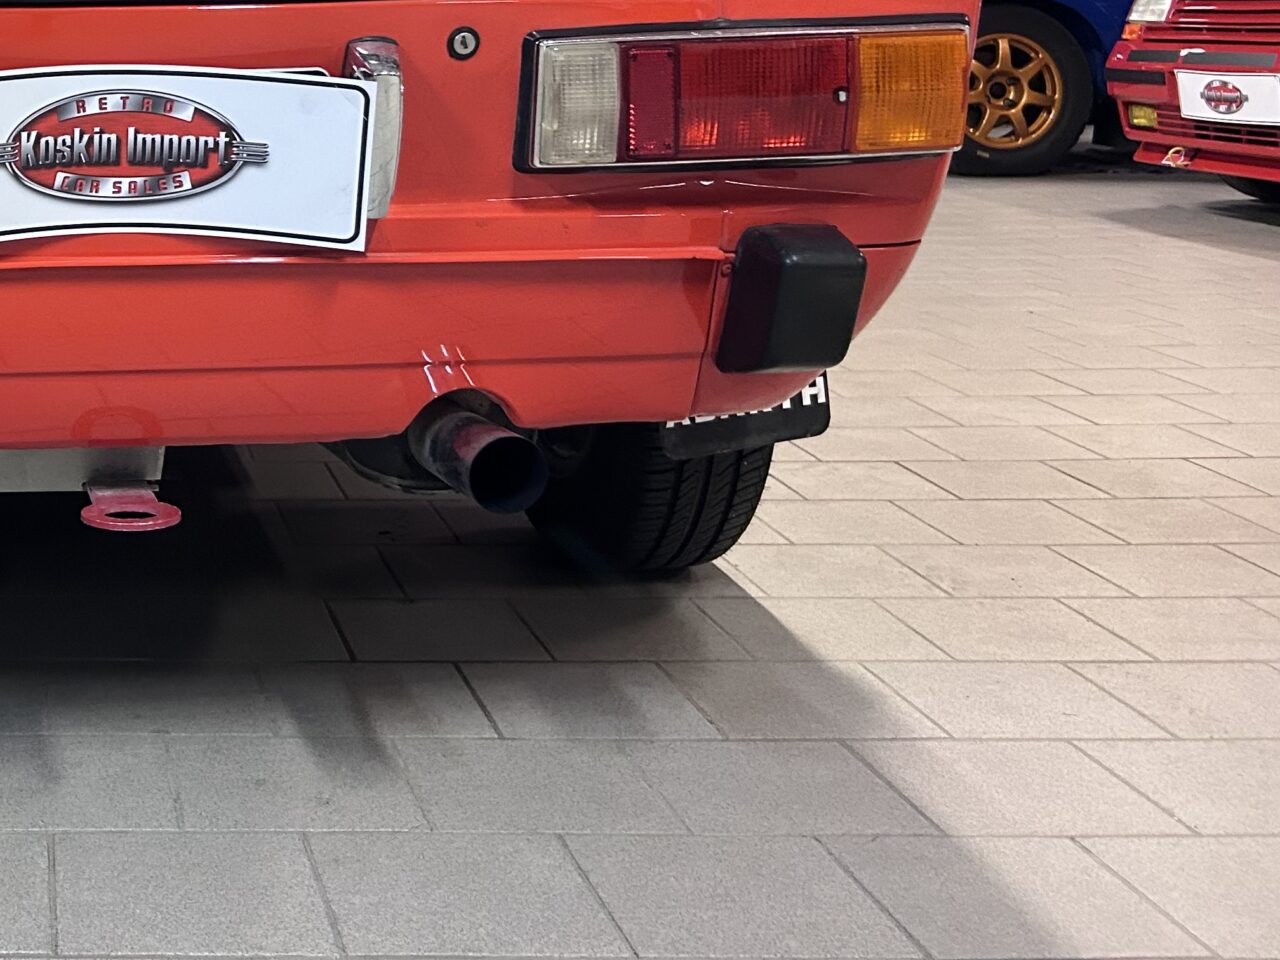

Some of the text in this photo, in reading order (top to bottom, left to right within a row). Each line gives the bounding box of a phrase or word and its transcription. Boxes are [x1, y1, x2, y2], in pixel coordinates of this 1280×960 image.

[76, 96, 176, 114] RETRO
[20, 126, 230, 168] Koskin Import
[61, 174, 184, 195] CAR SALES
